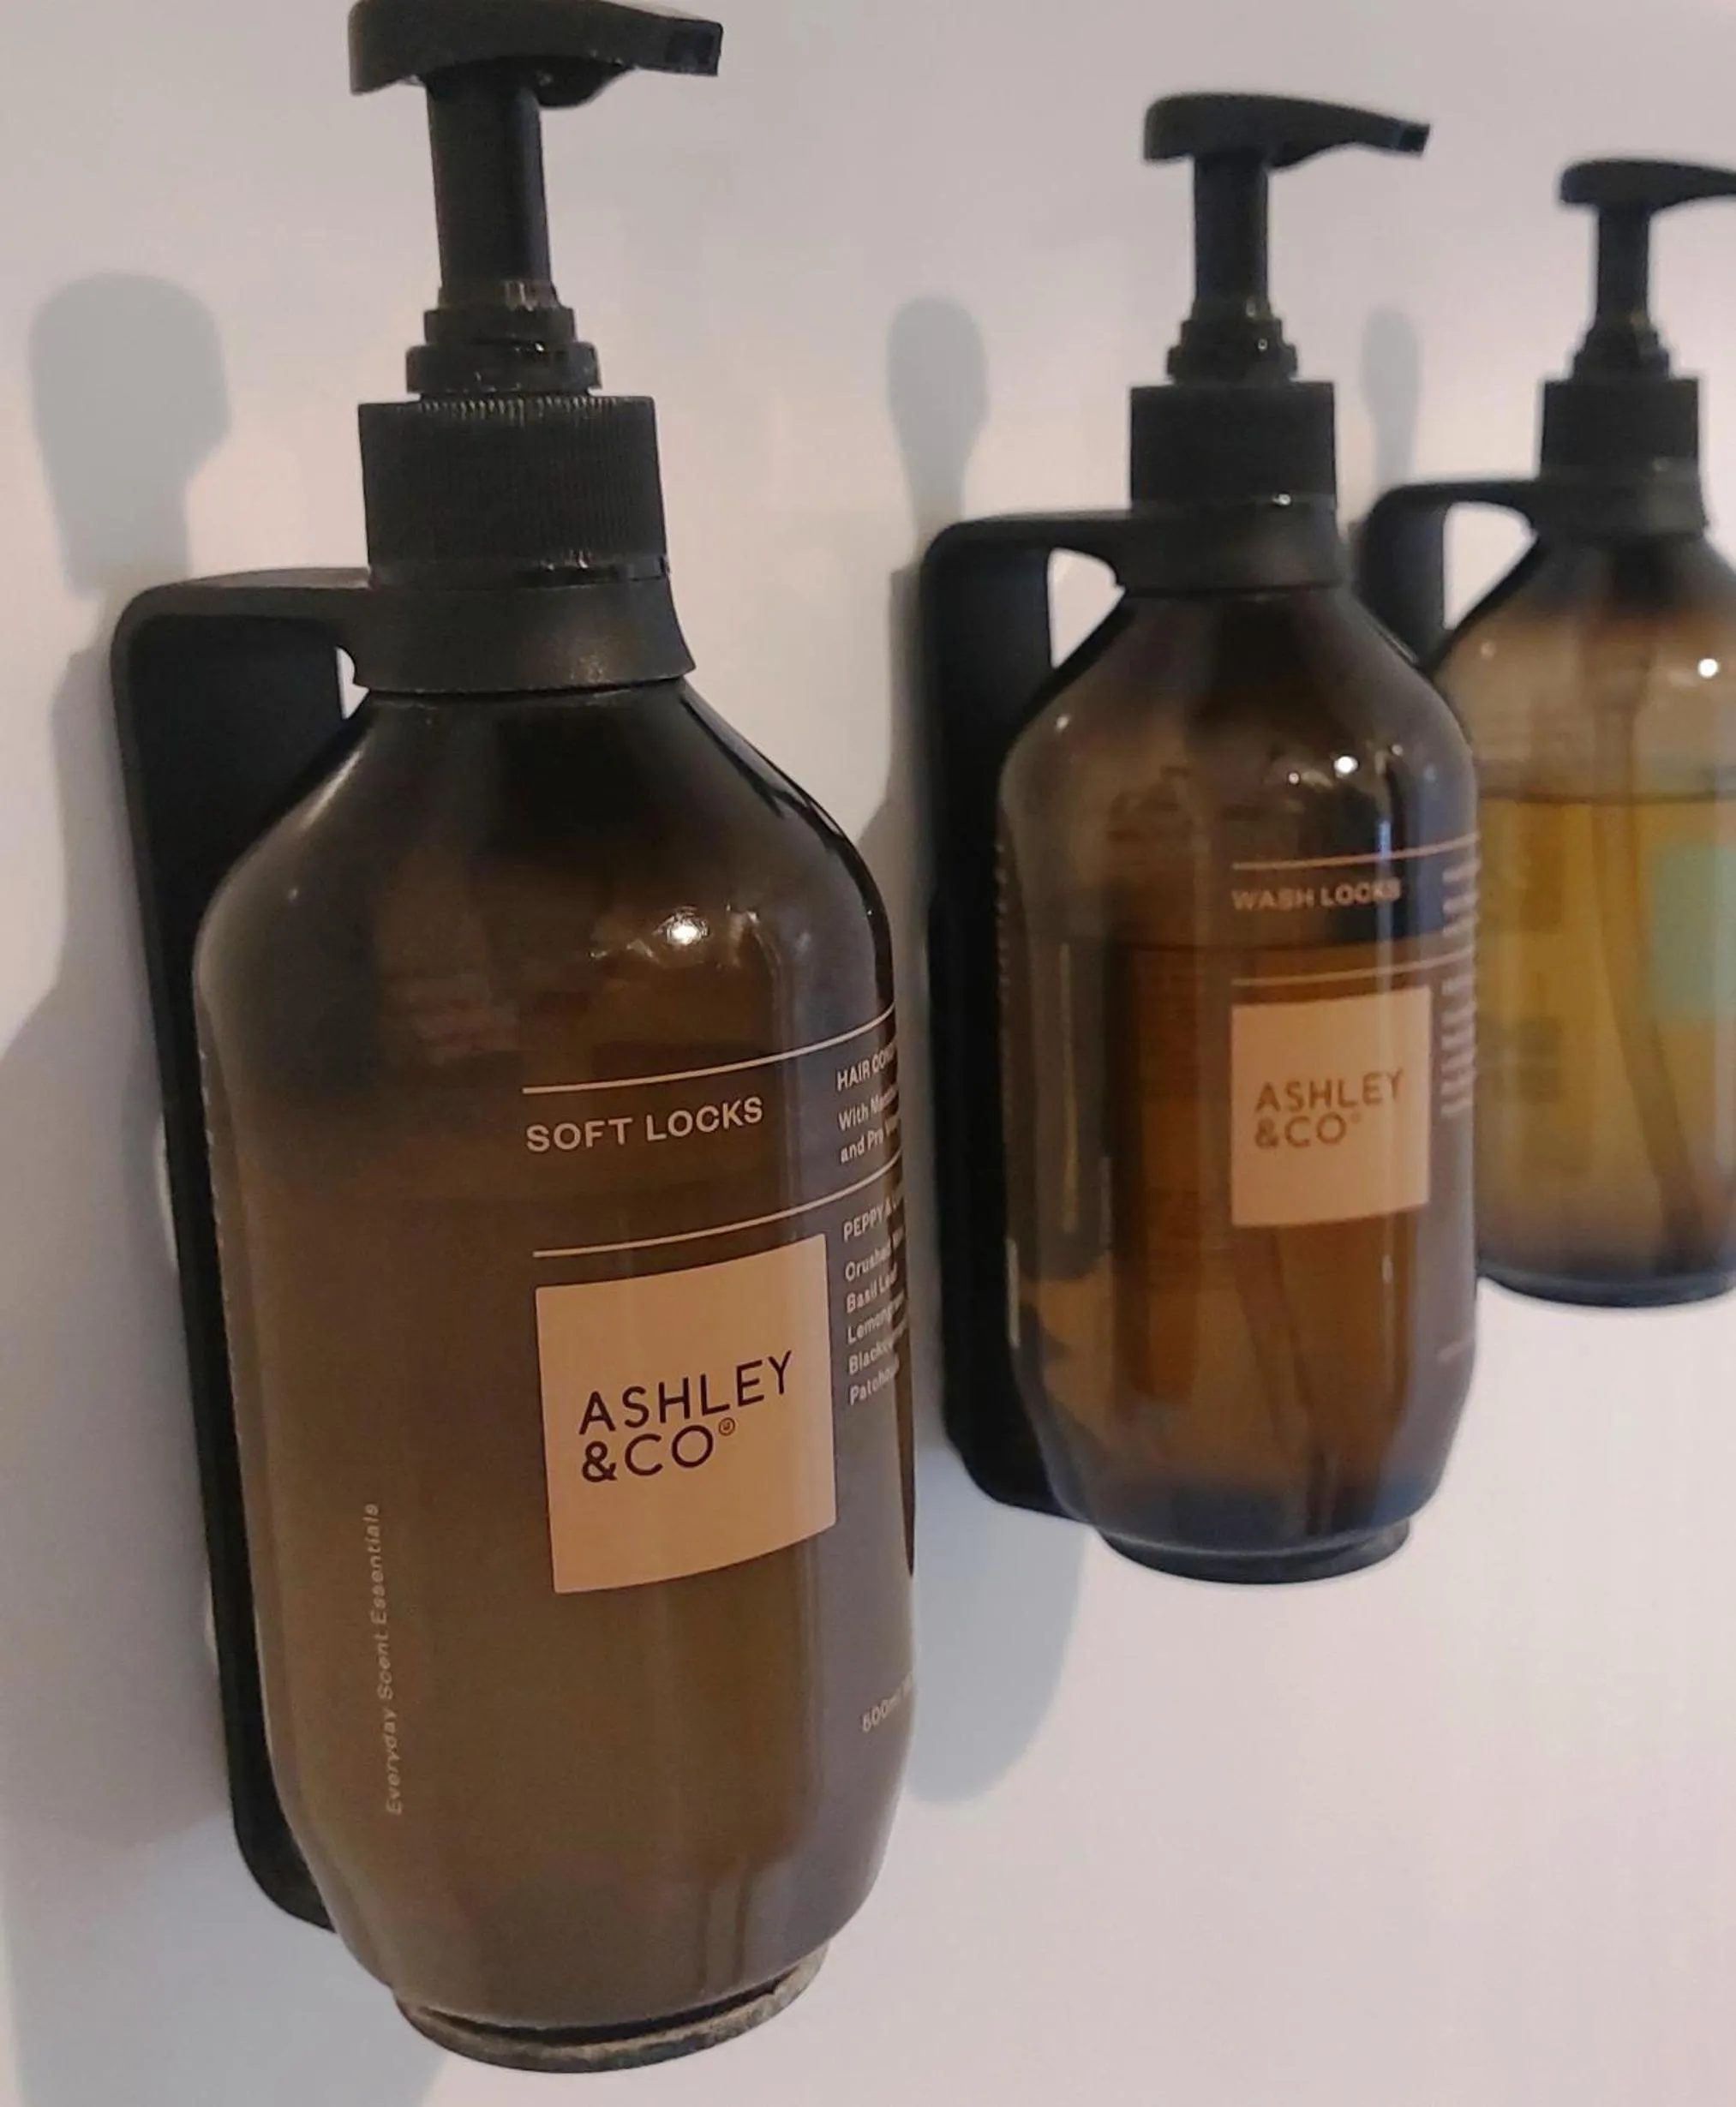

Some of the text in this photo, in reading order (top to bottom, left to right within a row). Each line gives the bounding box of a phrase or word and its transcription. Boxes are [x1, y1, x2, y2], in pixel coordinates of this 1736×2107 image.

[1231, 888, 1314, 911] WASH
[836, 1058, 871, 1092] HAIR
[1255, 1068, 1404, 1114] ASHLEY
[525, 1096, 763, 1153] SOFT LOCKS
[838, 1101, 869, 1132] With
[840, 1134, 865, 1164] and
[843, 1205, 884, 1242] PEPPY
[847, 1277, 878, 1314] Basil
[578, 1350, 792, 1436] ASHLEY
[362, 1503, 404, 1815] Everyday Scent Essentials
